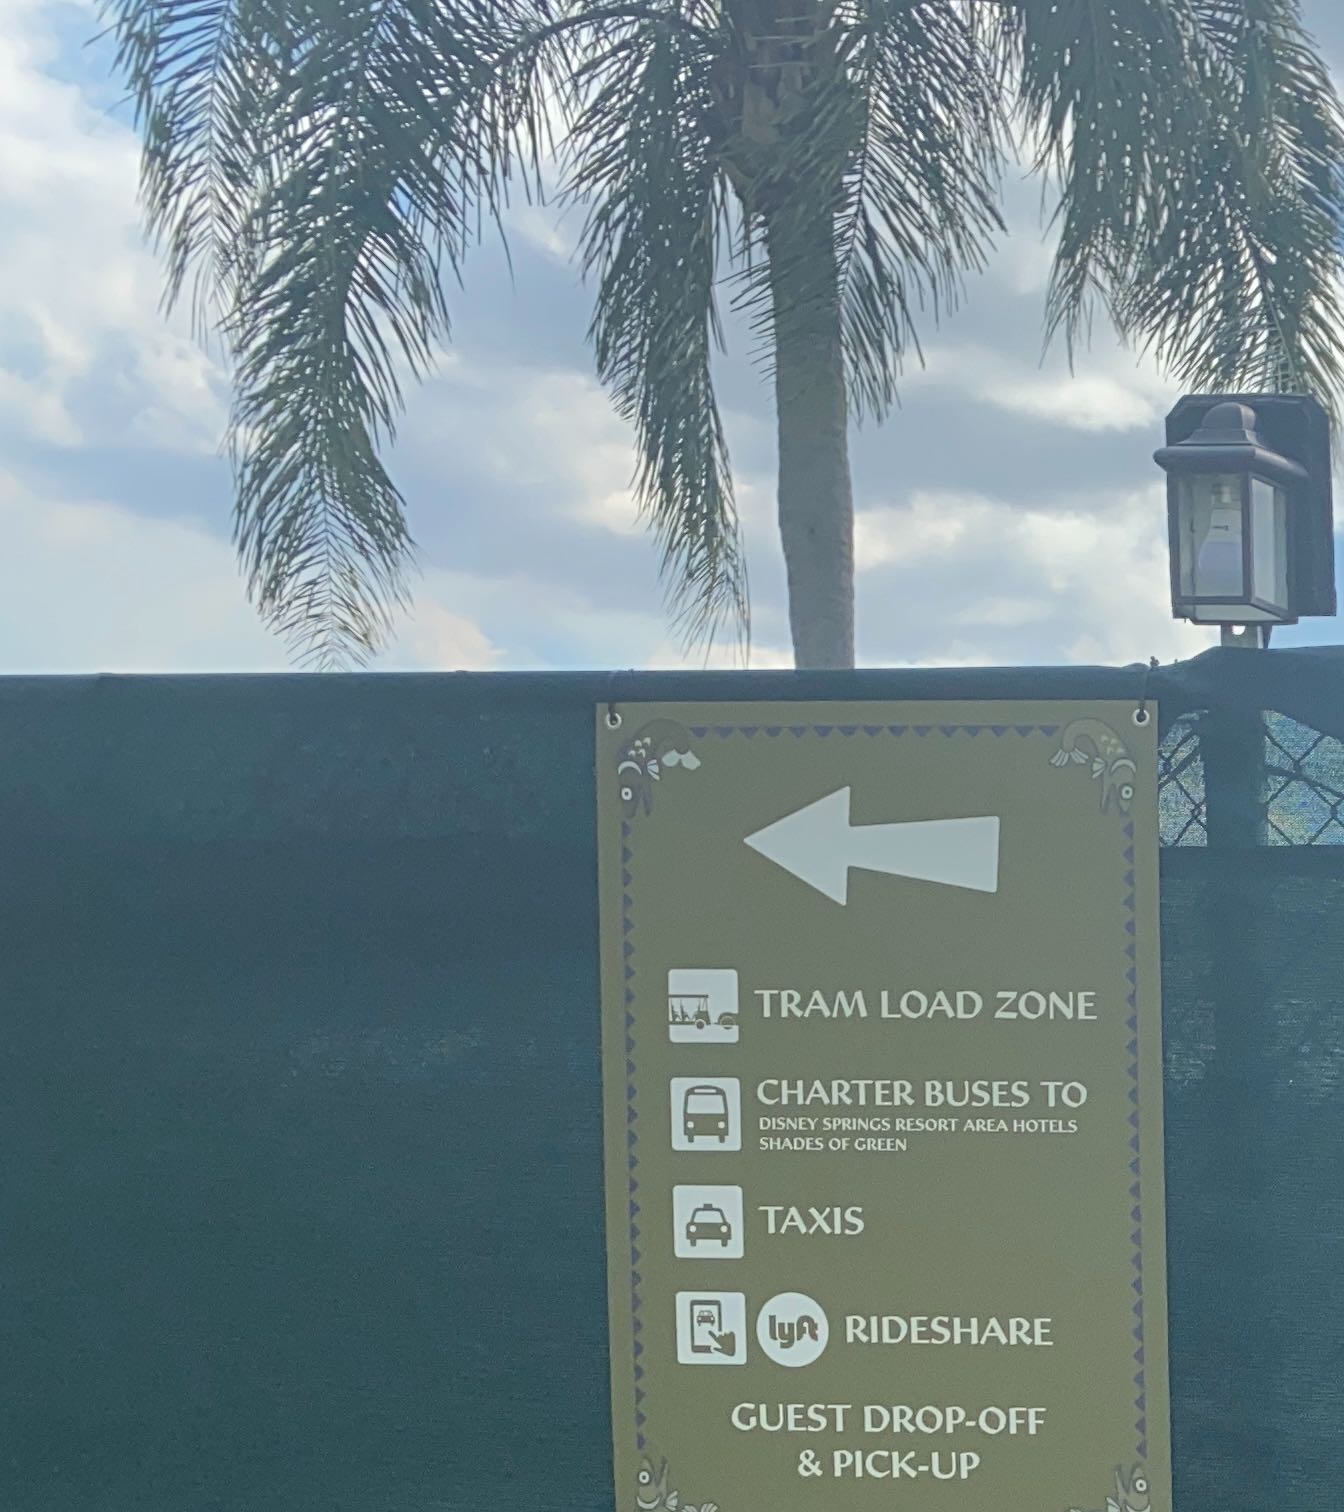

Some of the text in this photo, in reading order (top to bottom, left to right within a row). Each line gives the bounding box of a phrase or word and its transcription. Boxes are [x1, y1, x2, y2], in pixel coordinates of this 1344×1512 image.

[754, 990, 1097, 1020] TRAM LOAD ZONE
[757, 1079, 1087, 1108] CHARTER BUSES TO
[759, 1117, 1078, 1133] DISNEY SPRINGS RESORT AREA HOTELS
[759, 1137, 907, 1152] SHADES OF GREEN
[758, 1206, 865, 1235] TAXIS
[768, 1315, 1053, 1349] lyft RIDESHARE
[731, 1403, 1046, 1435] GUEST DROP-OFF
[797, 1449, 980, 1479] & PICK-UP
